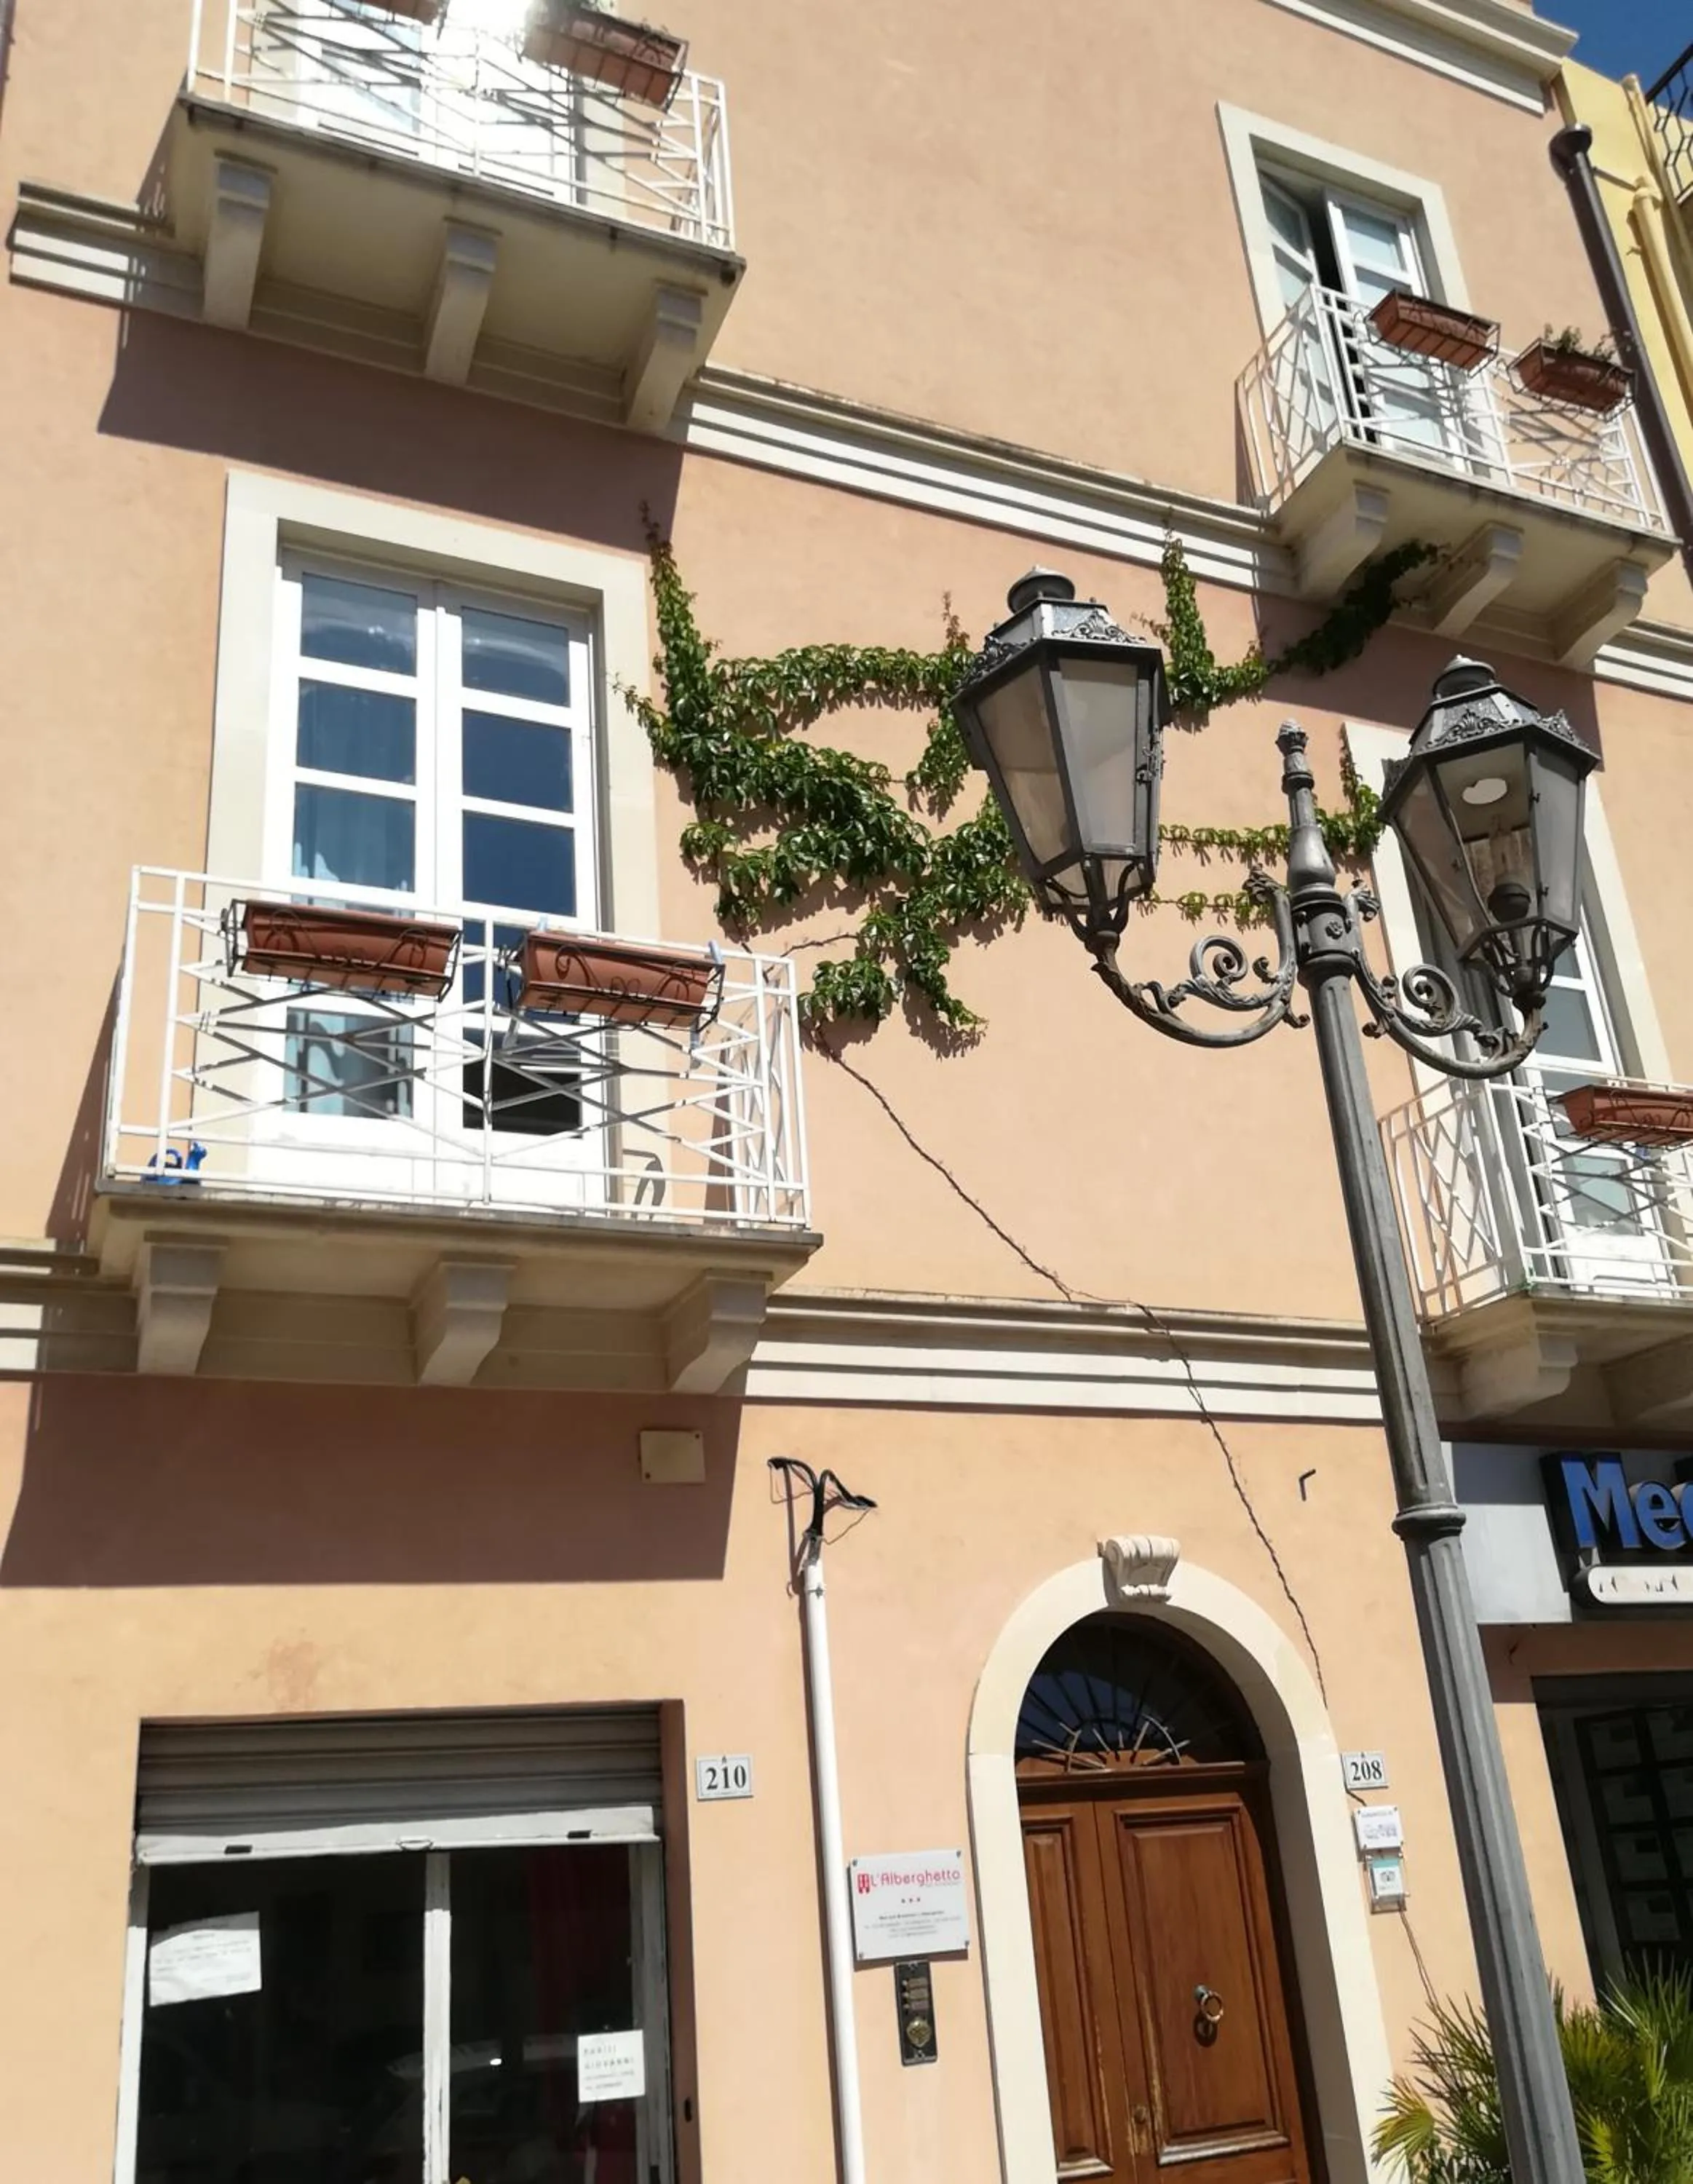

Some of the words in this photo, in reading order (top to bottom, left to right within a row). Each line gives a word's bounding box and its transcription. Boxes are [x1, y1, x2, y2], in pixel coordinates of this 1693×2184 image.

[705, 1765, 747, 1790] 210
[1351, 1760, 1382, 1781] 208
[871, 1869, 961, 1888] L'Alberghetto
